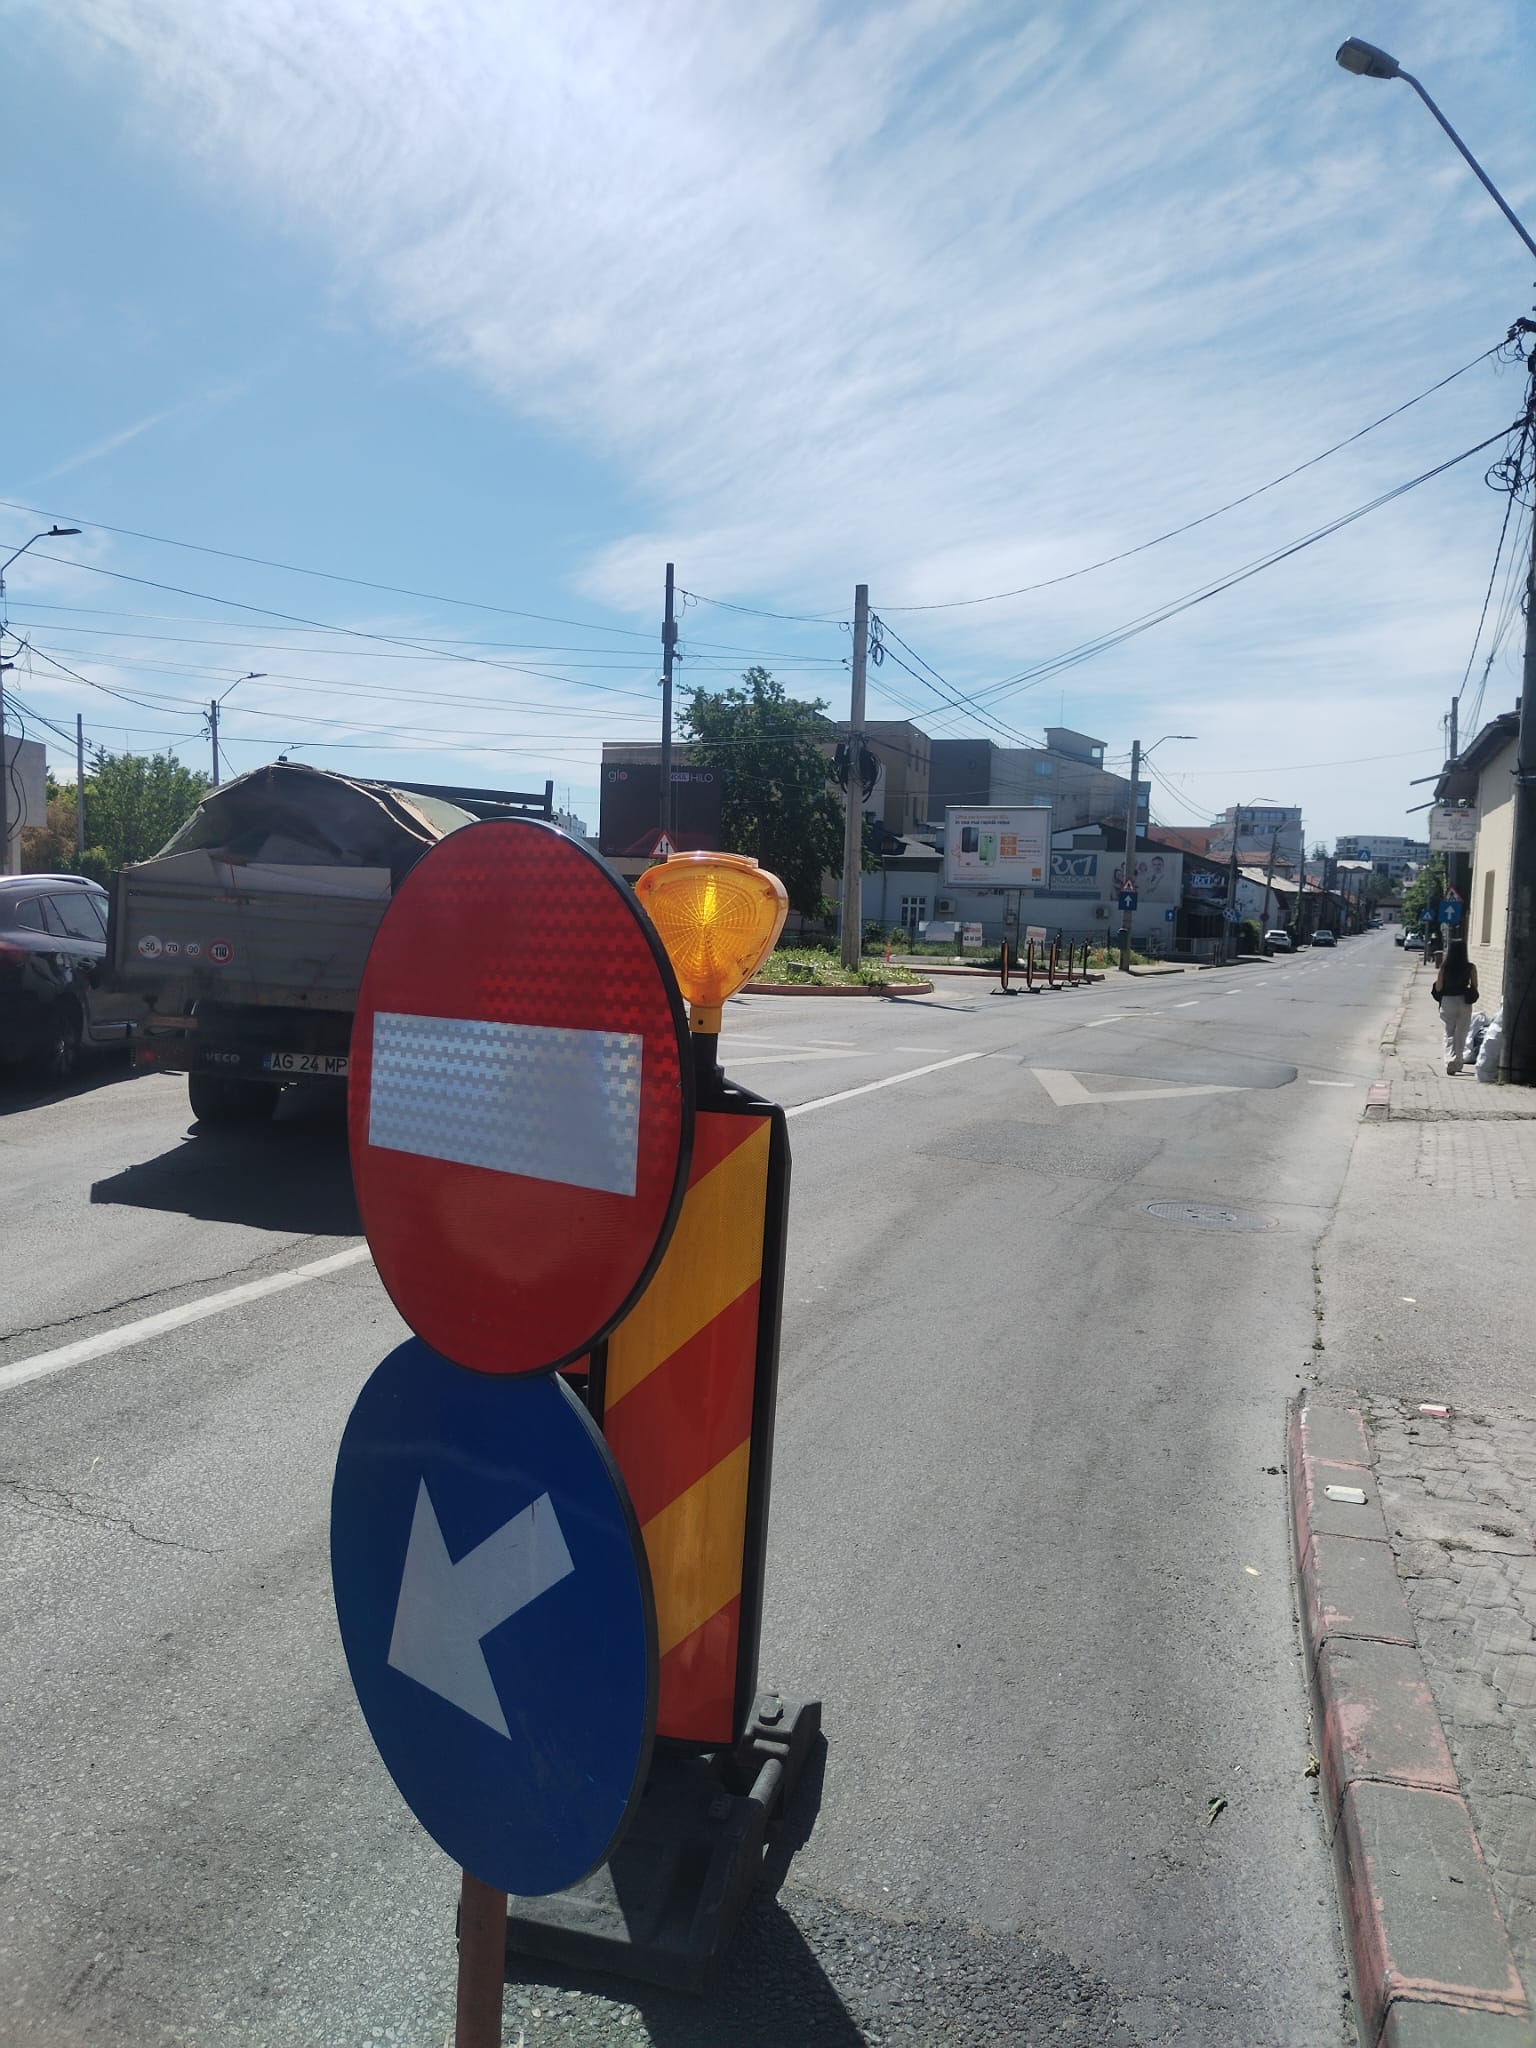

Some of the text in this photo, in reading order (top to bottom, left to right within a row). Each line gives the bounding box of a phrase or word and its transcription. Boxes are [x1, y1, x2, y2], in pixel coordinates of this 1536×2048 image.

[608, 769, 628, 783] glo
[145, 942, 155, 951] 50
[167, 944, 178, 952] 70
[188, 945, 199, 954] 90
[215, 946, 227, 958] 110
[272, 1053, 294, 1070] AG
[299, 1055, 319, 1071] 24
